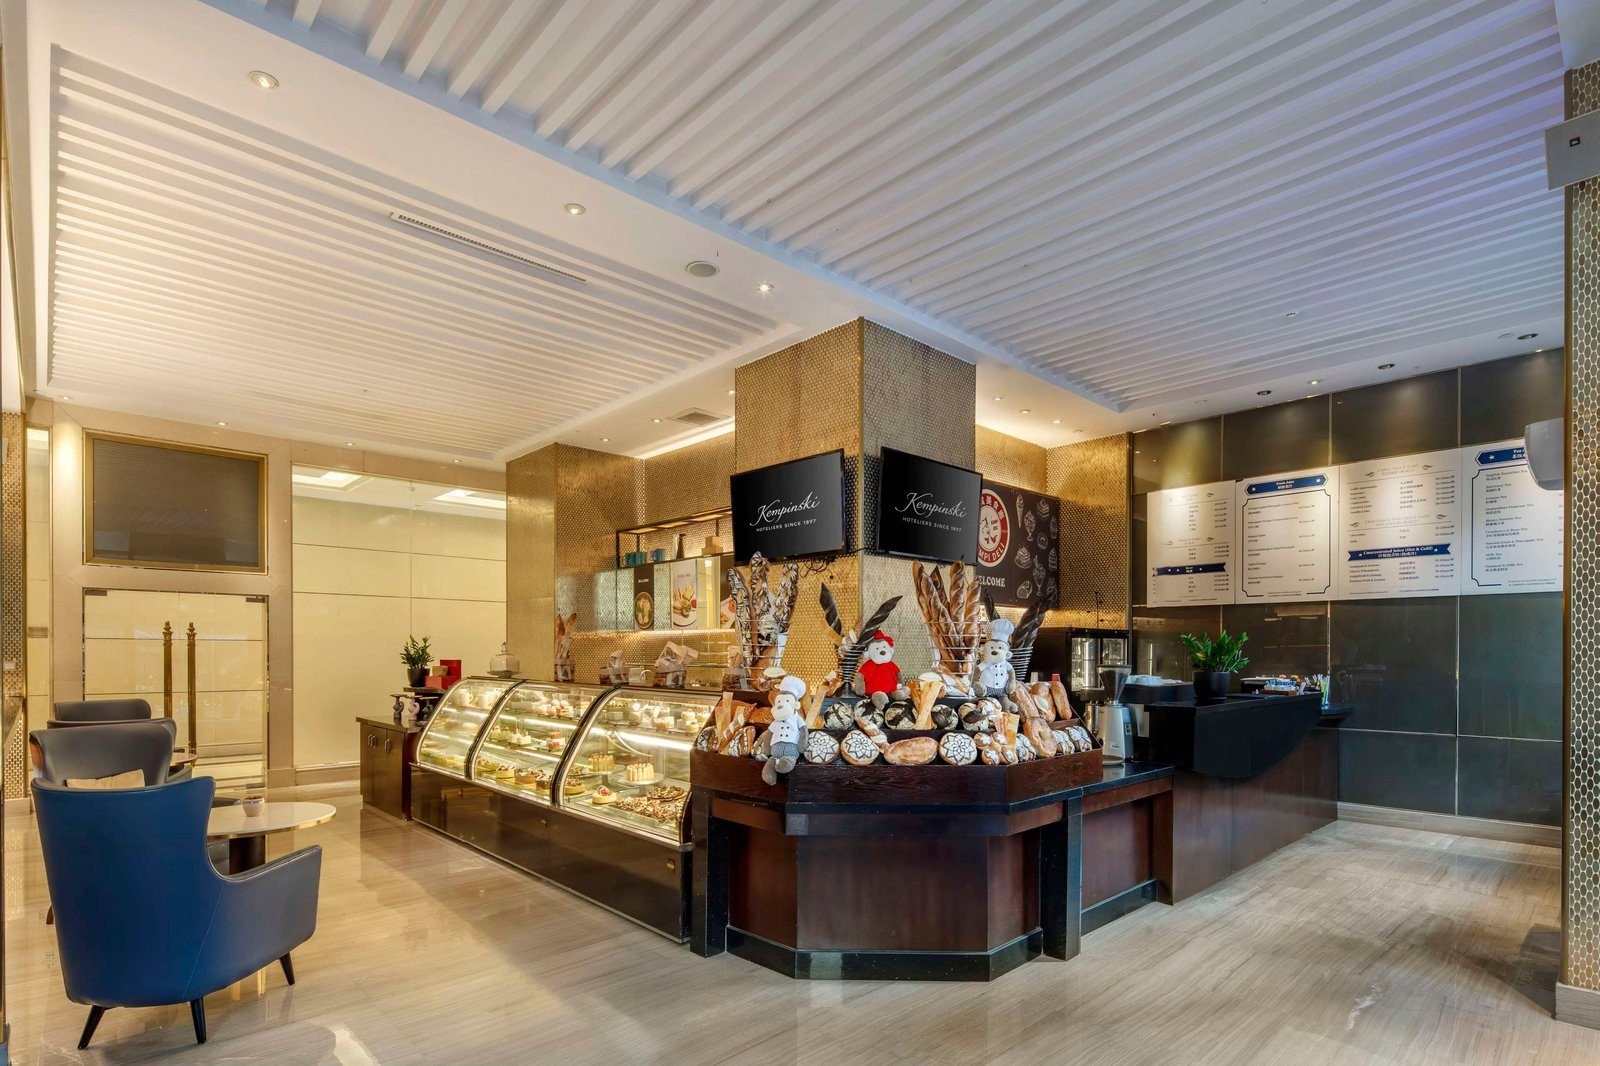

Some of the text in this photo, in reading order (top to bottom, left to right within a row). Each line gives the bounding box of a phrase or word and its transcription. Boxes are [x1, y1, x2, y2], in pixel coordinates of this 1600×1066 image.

[750, 491, 820, 526] Kempinski
[895, 493, 966, 518] Kempinski
[756, 524, 783, 532] HOTELIERS
[903, 516, 932, 526] HOTELIERS
[934, 522, 949, 530] SINCE
[978, 543, 1005, 562] MPI DELI
[976, 575, 1005, 587] ELCOME
